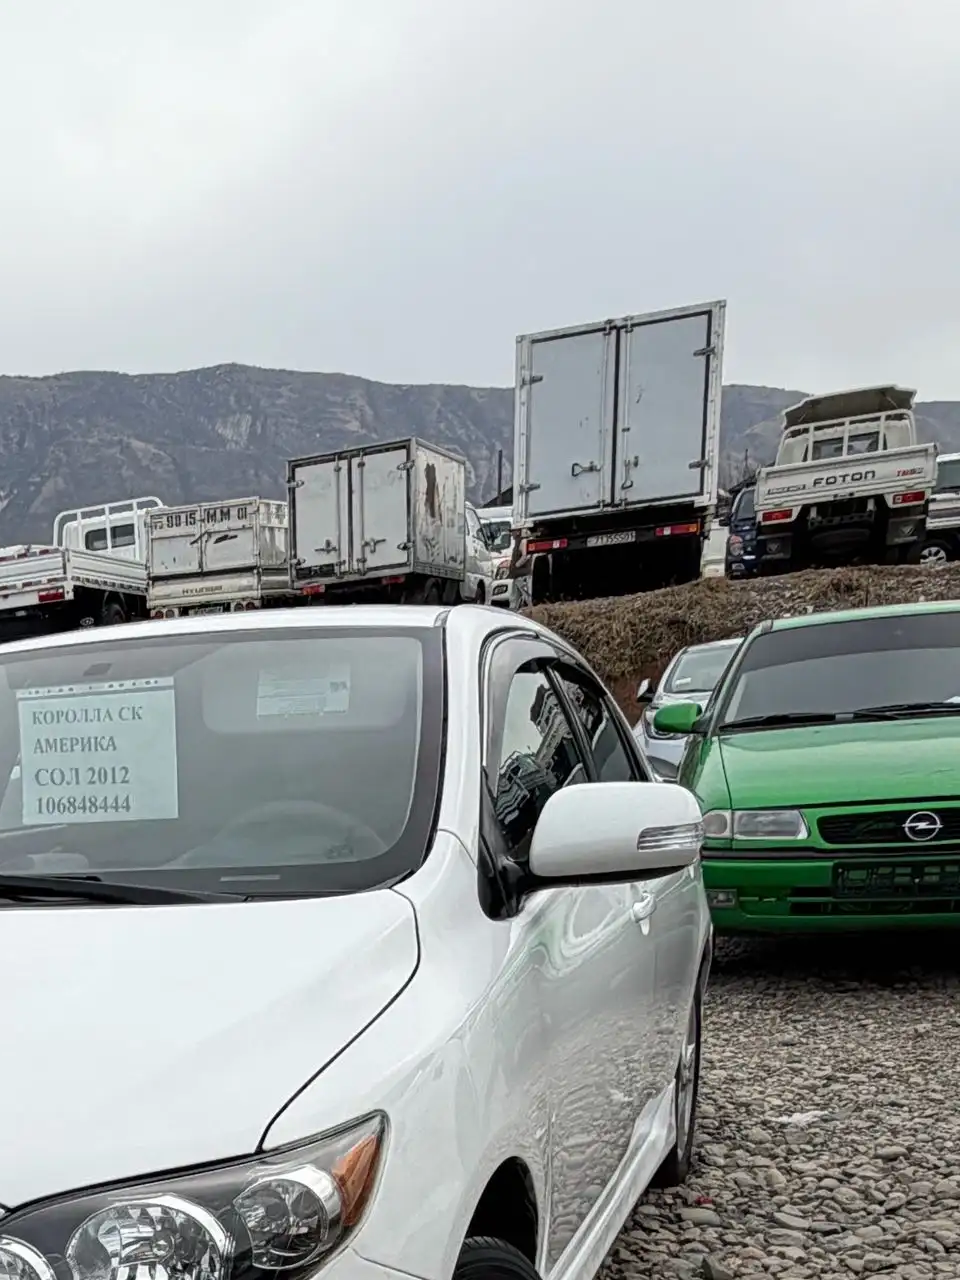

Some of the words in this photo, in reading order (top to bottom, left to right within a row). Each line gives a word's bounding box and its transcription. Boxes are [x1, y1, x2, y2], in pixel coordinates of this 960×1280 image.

[813, 470, 876, 487] FOTON
[31, 707, 114, 726] КОРОЛЛА
[33, 735, 118, 755] АМЕРИКА
[34, 766, 81, 787] СОЛ
[87, 765, 131, 785] 2012
[36, 794, 132, 815] 106848444
